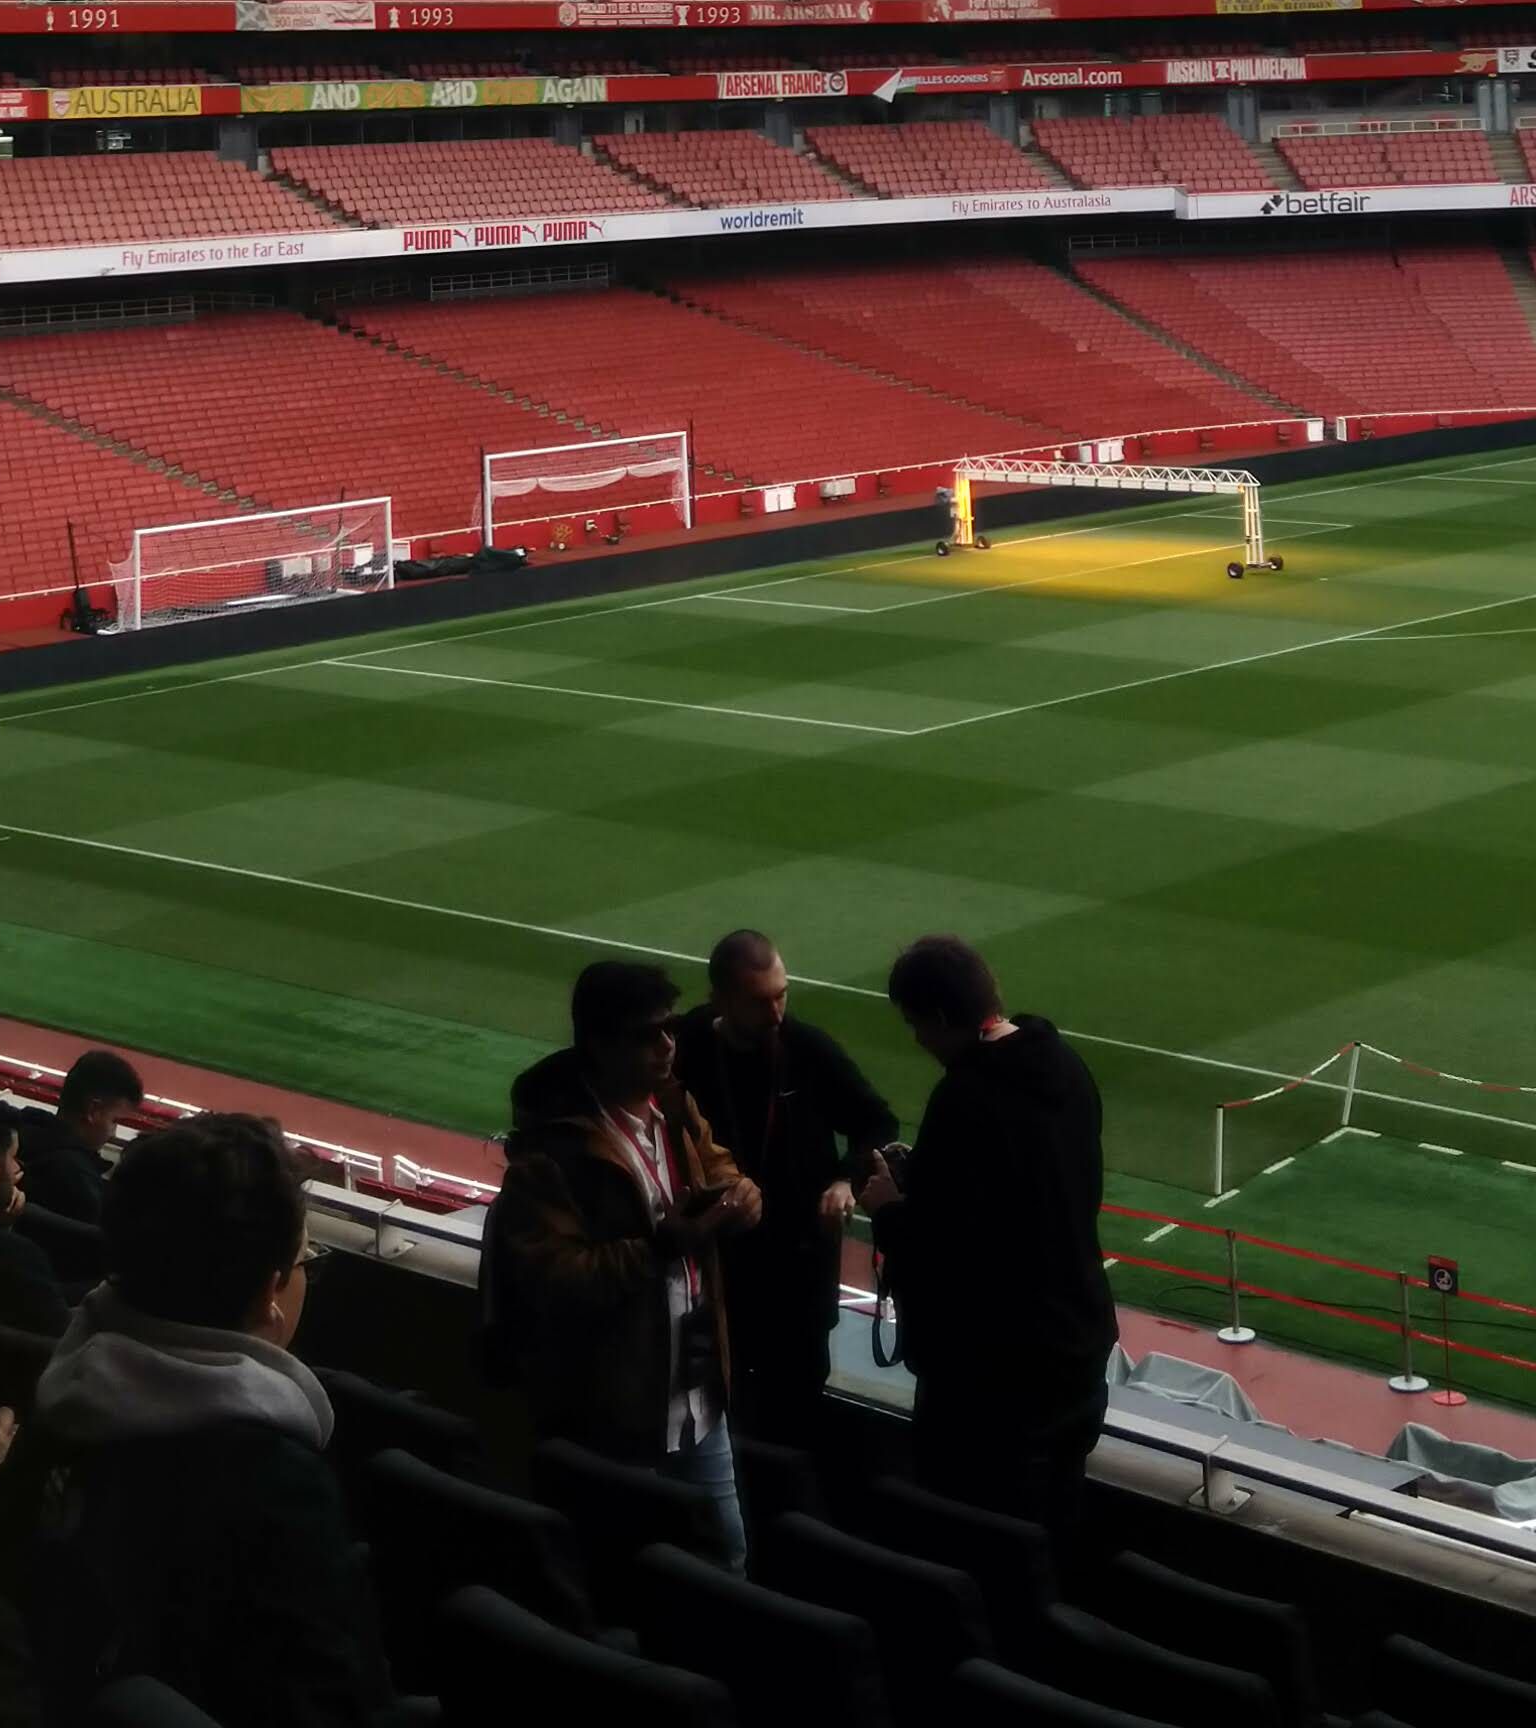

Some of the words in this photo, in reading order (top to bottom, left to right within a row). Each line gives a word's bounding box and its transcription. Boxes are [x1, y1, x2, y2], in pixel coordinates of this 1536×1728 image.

[69, 9, 119, 28] 1991
[410, 8, 454, 26] 1993
[697, 7, 741, 24] 1993
[750, 5, 781, 21] MR.
[783, 4, 856, 21] ARSENAL
[944, 74, 989, 84] GOONERS
[1022, 67, 1122, 86] Arsenal.com
[1167, 60, 1215, 84] ARSENAL
[1230, 57, 1307, 81] PHILADELPHIA
[311, 84, 361, 110] AND
[431, 81, 478, 107] AND
[543, 78, 606, 104] AGAIN
[725, 73, 779, 97] ARSENAL
[781, 72, 828, 95] FRANCE
[74, 87, 199, 115] AUSTRALIA
[952, 200, 968, 216] Fly
[973, 198, 1024, 213] Emirates
[1027, 198, 1040, 210] to
[1044, 194, 1112, 209] Australasia
[1286, 191, 1371, 215] betfair
[720, 207, 804, 231] worldremit
[404, 228, 452, 252] PUMA
[474, 225, 521, 247] PUMA
[542, 221, 588, 243] PUMA
[122, 250, 144, 269] Fly
[148, 246, 206, 266] Emirates
[209, 247, 224, 262] to
[227, 244, 249, 260] the
[253, 243, 273, 258] Far
[277, 241, 305, 257] East
